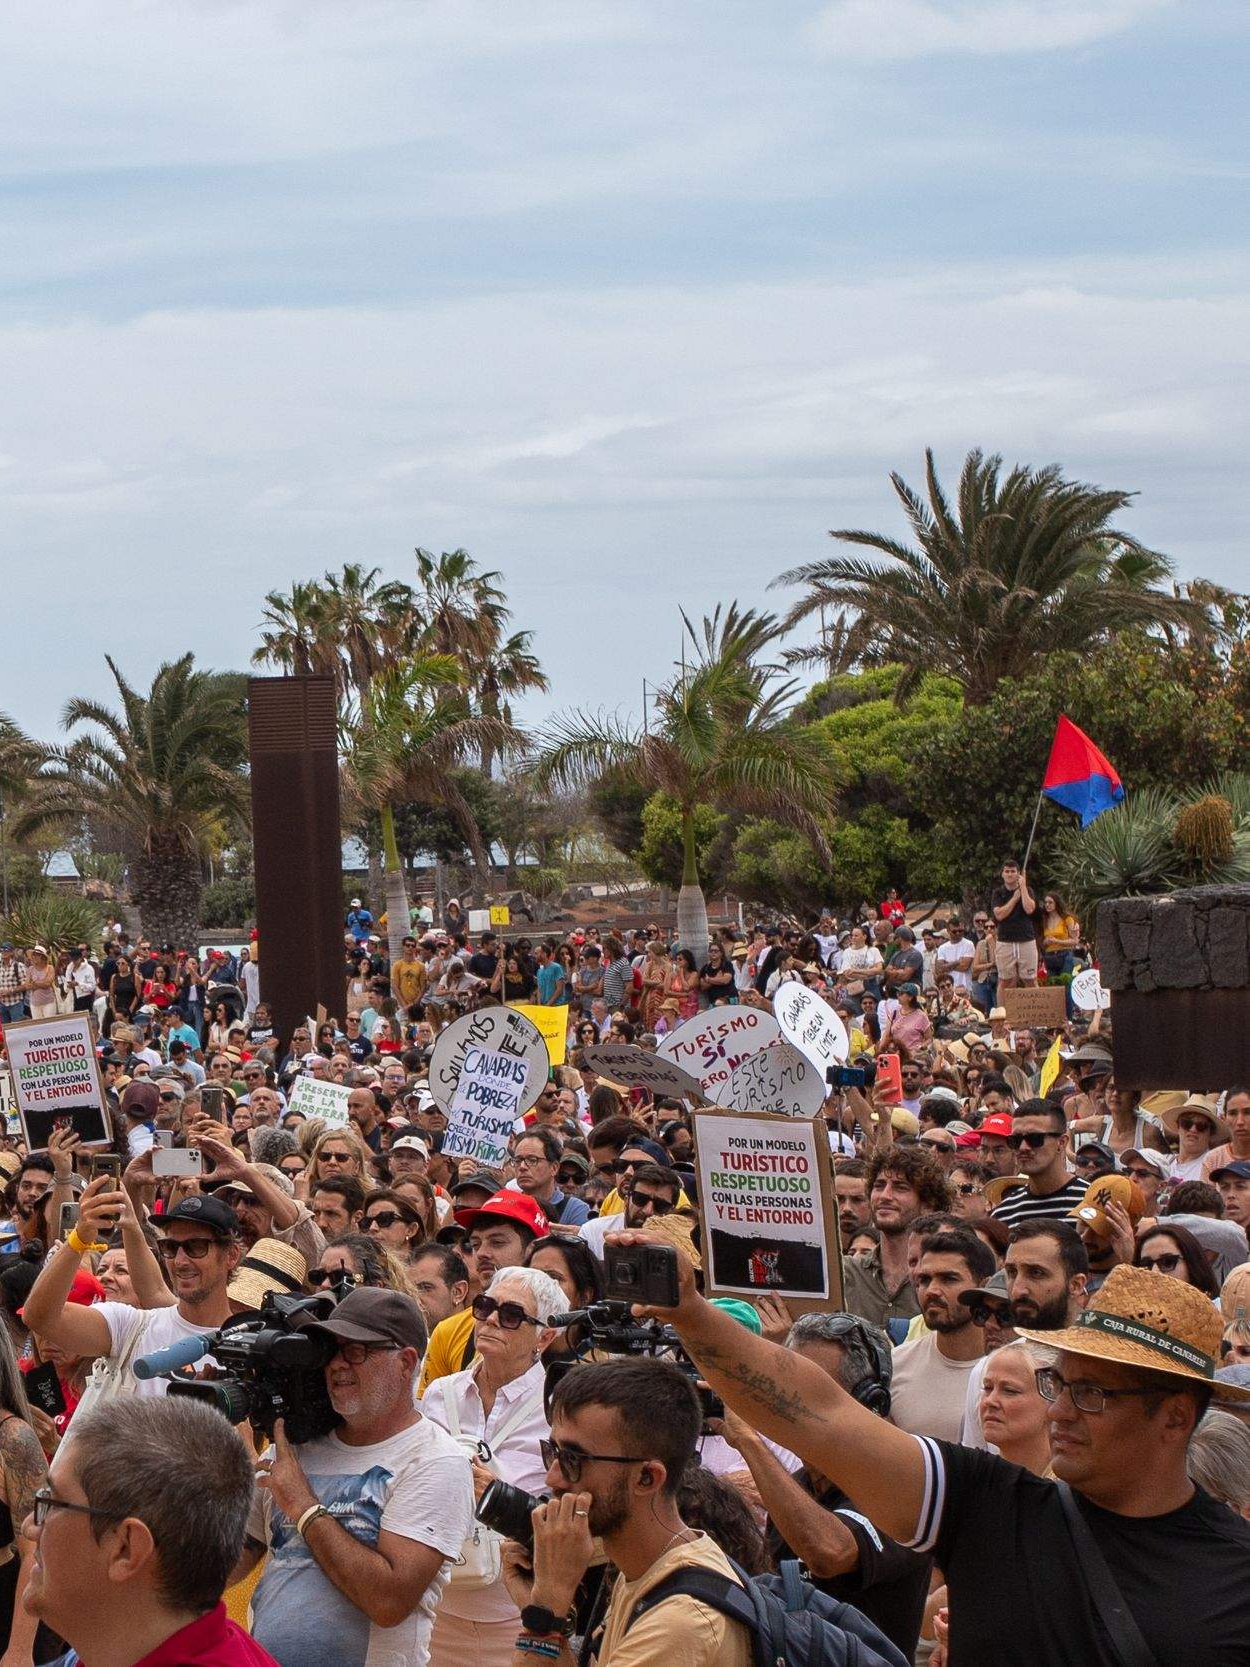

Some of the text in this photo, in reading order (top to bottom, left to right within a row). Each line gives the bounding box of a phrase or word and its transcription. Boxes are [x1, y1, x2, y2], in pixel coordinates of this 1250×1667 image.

[29, 1033, 83, 1048] POR UN MODELO
[668, 1014, 758, 1062] TURISMO
[25, 1044, 85, 1065] TURÍSTICO
[19, 1060, 88, 1080] RESPETUOSO
[464, 1049, 527, 1085] CANARIAS
[21, 1073, 91, 1091] CON LAS PERSONAS
[25, 1083, 93, 1102] Y EL ENTORNO
[302, 1093, 335, 1108] DE LA
[466, 1081, 518, 1113] POBREZA
[443, 1132, 476, 1155] MISMO
[728, 1137, 806, 1152] POR UN MODELO
[720, 1151, 809, 1174] TURÍSTICO
[710, 1171, 810, 1193] RESPETUOSO
[712, 1192, 813, 1209] CON LAS PERSONAS
[716, 1205, 814, 1225] Y EL ENTORNO
[1103, 1318, 1125, 1332] CAJA
[1125, 1326, 1157, 1344] RURAL
[1157, 1339, 1172, 1350] DE
